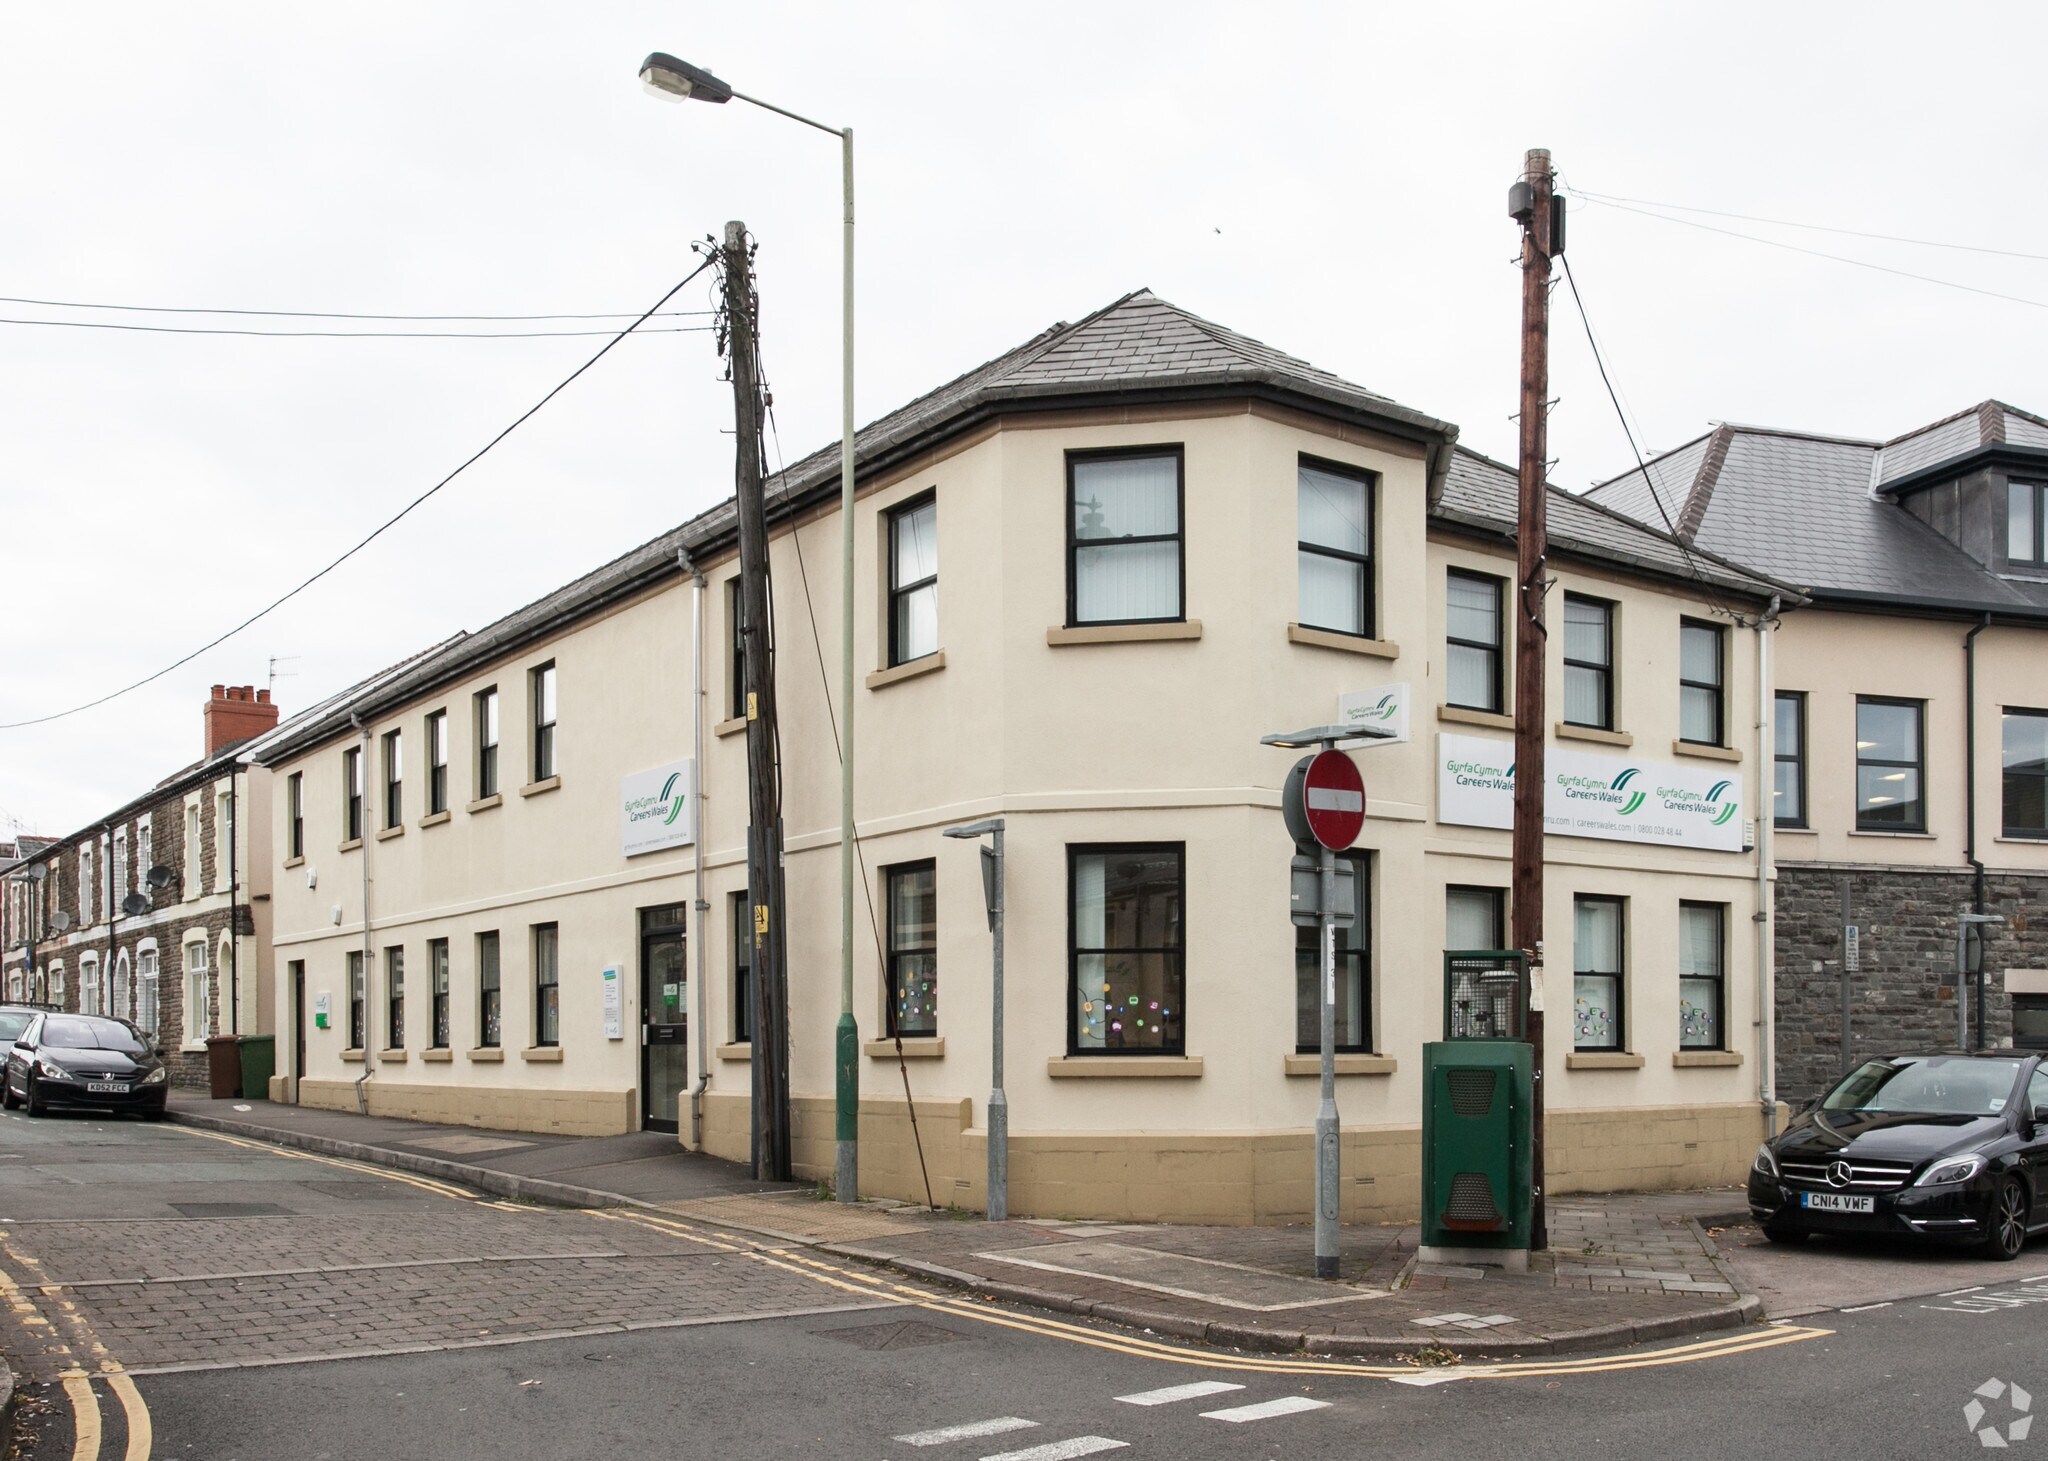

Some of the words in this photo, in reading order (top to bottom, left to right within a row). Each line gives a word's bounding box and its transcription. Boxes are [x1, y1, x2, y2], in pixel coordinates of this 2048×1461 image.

[1492, 779, 1515, 791] Wale
[1812, 1194, 1839, 1208] CN14
[1844, 1196, 1869, 1210] VWF
